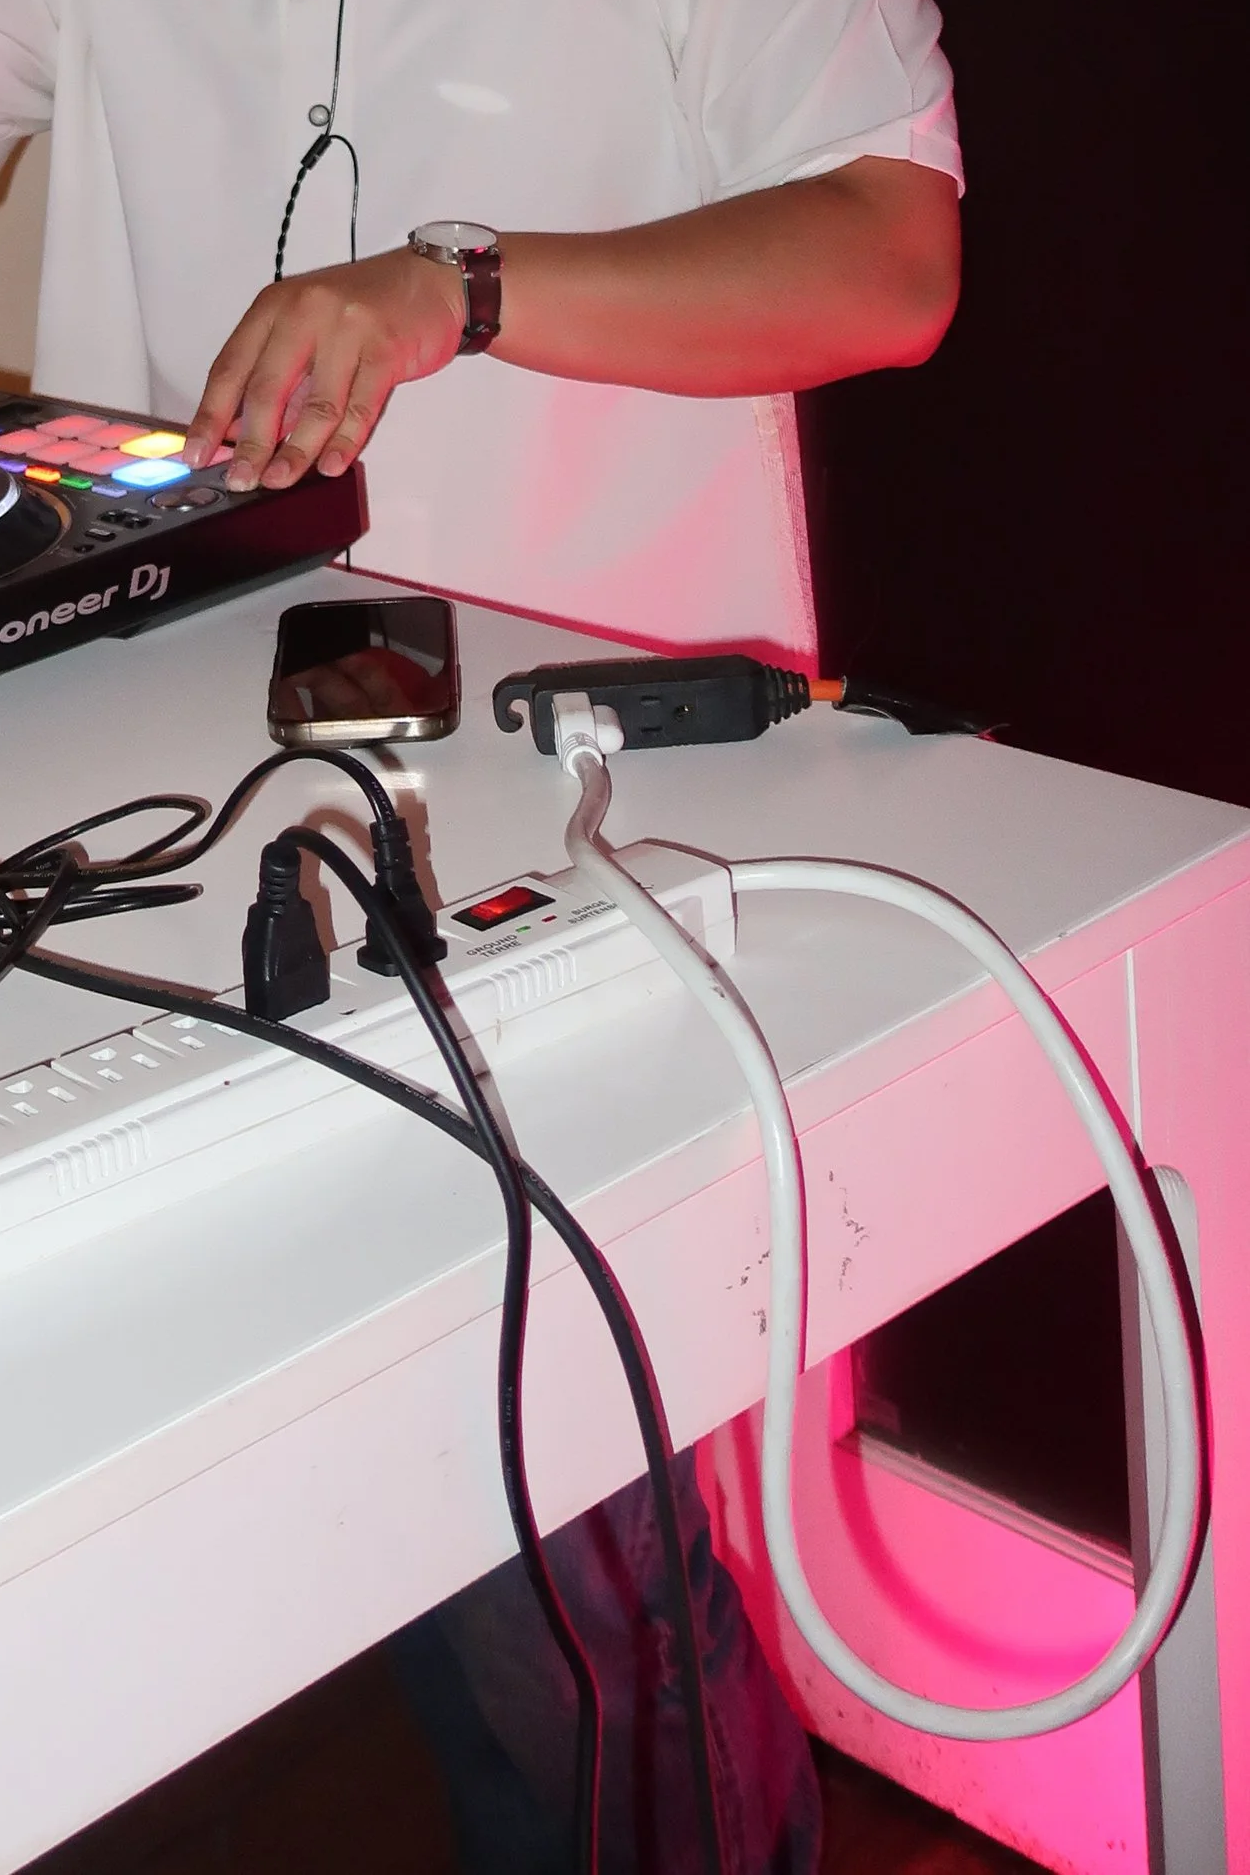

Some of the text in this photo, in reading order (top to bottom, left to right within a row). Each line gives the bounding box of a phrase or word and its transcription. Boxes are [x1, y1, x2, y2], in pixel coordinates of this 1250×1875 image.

[128, 563, 171, 600] DJ
[571, 899, 608, 915] SURGE
[466, 934, 517, 956] GROUND
[480, 940, 522, 959] TERRE
